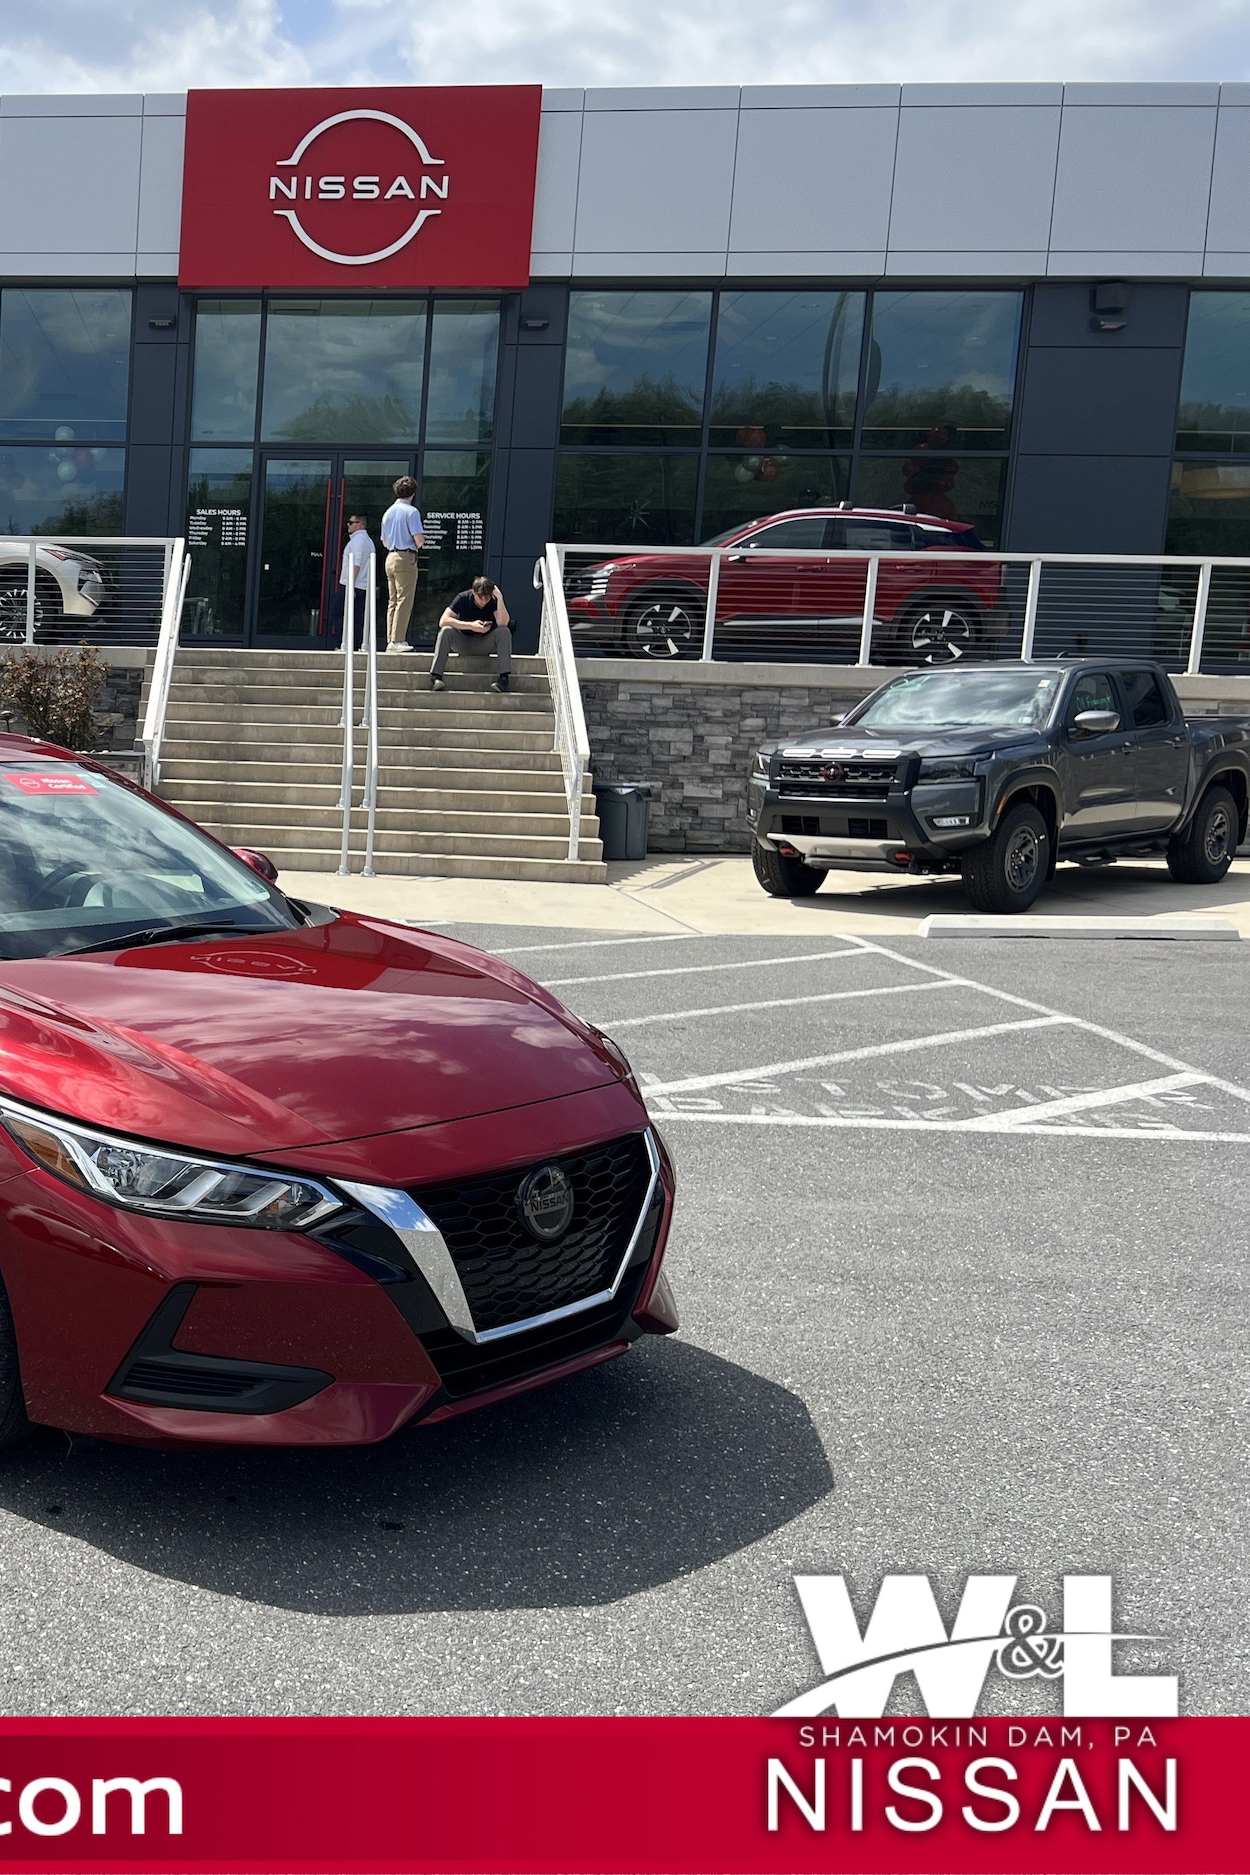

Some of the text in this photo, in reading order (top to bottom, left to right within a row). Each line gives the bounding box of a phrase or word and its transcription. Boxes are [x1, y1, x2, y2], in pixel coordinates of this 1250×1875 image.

[269, 175, 449, 199] NISSAN
[196, 508, 217, 516] SALES
[530, 1194, 569, 1213] NISSAN
